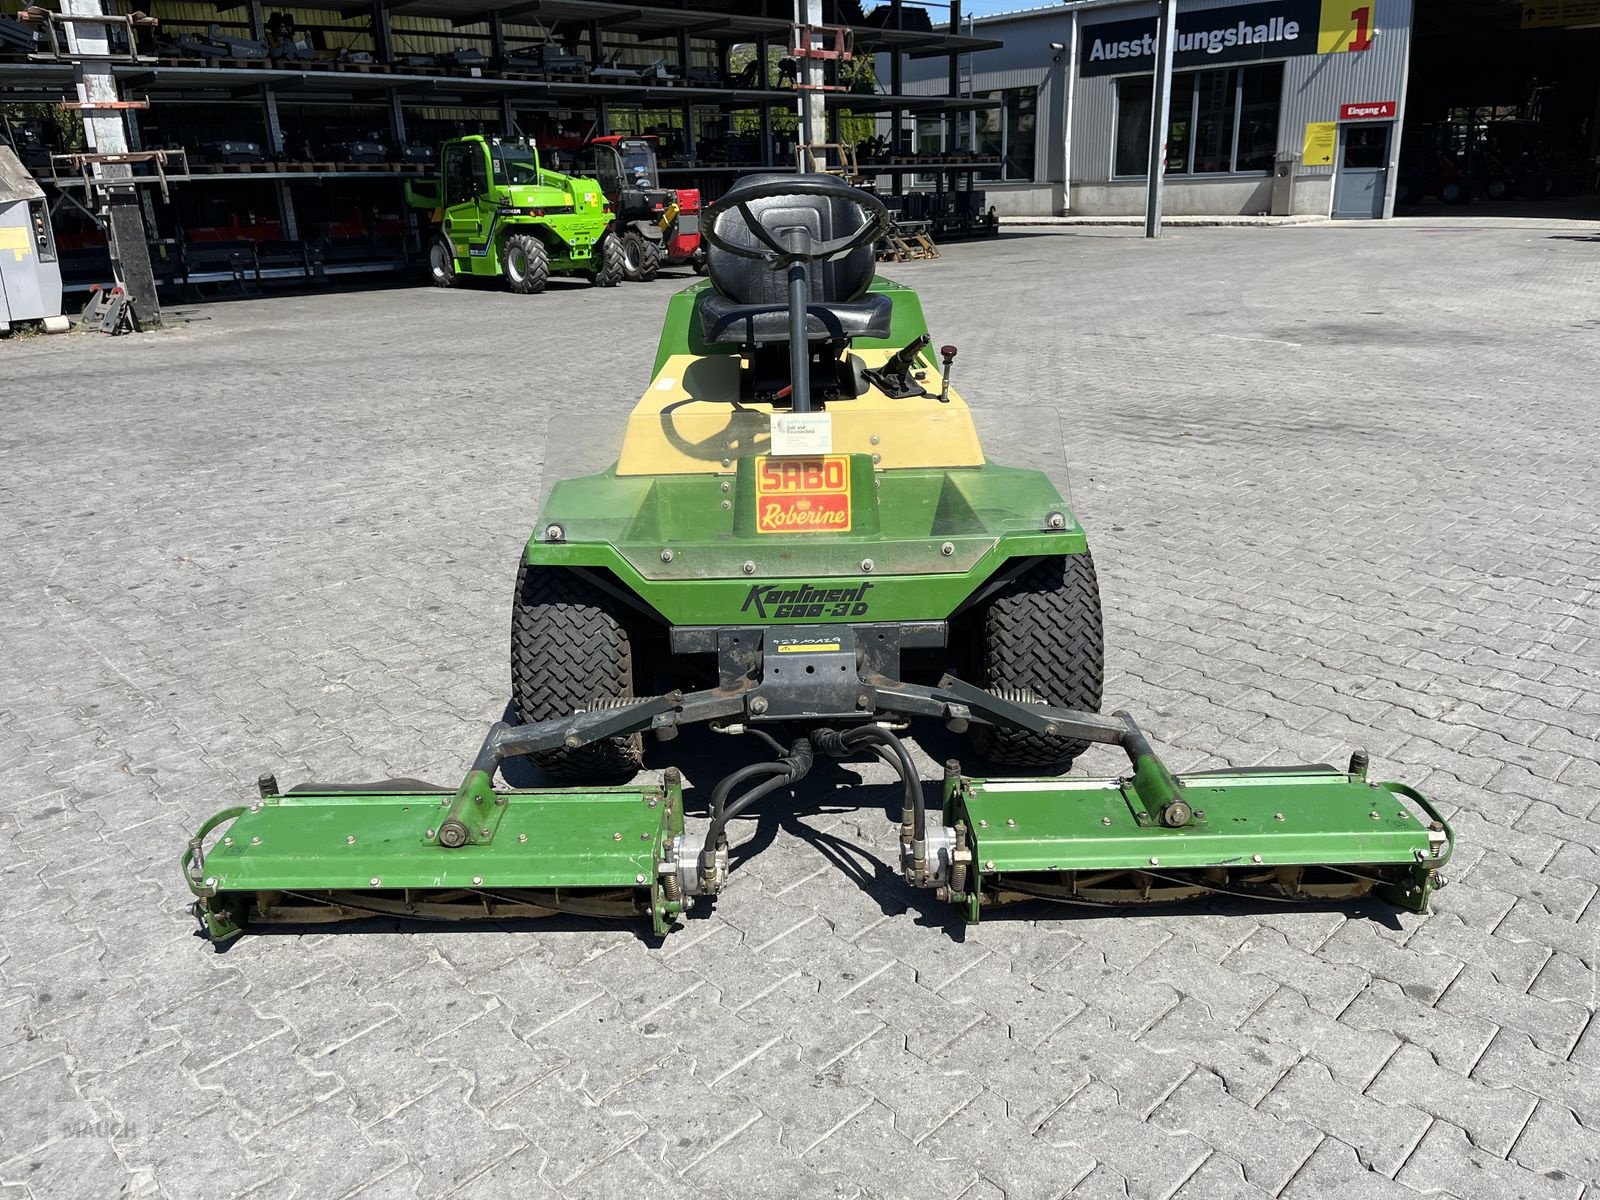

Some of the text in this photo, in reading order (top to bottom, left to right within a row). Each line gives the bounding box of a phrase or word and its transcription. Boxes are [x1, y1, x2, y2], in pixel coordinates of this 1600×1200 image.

[1089, 6, 1372, 62] Ausstlungshalle 1
[1347, 105, 1387, 116] Eingang A
[762, 461, 843, 491] SABO
[762, 503, 846, 528] Roberine
[741, 582, 875, 619] Kontinent
